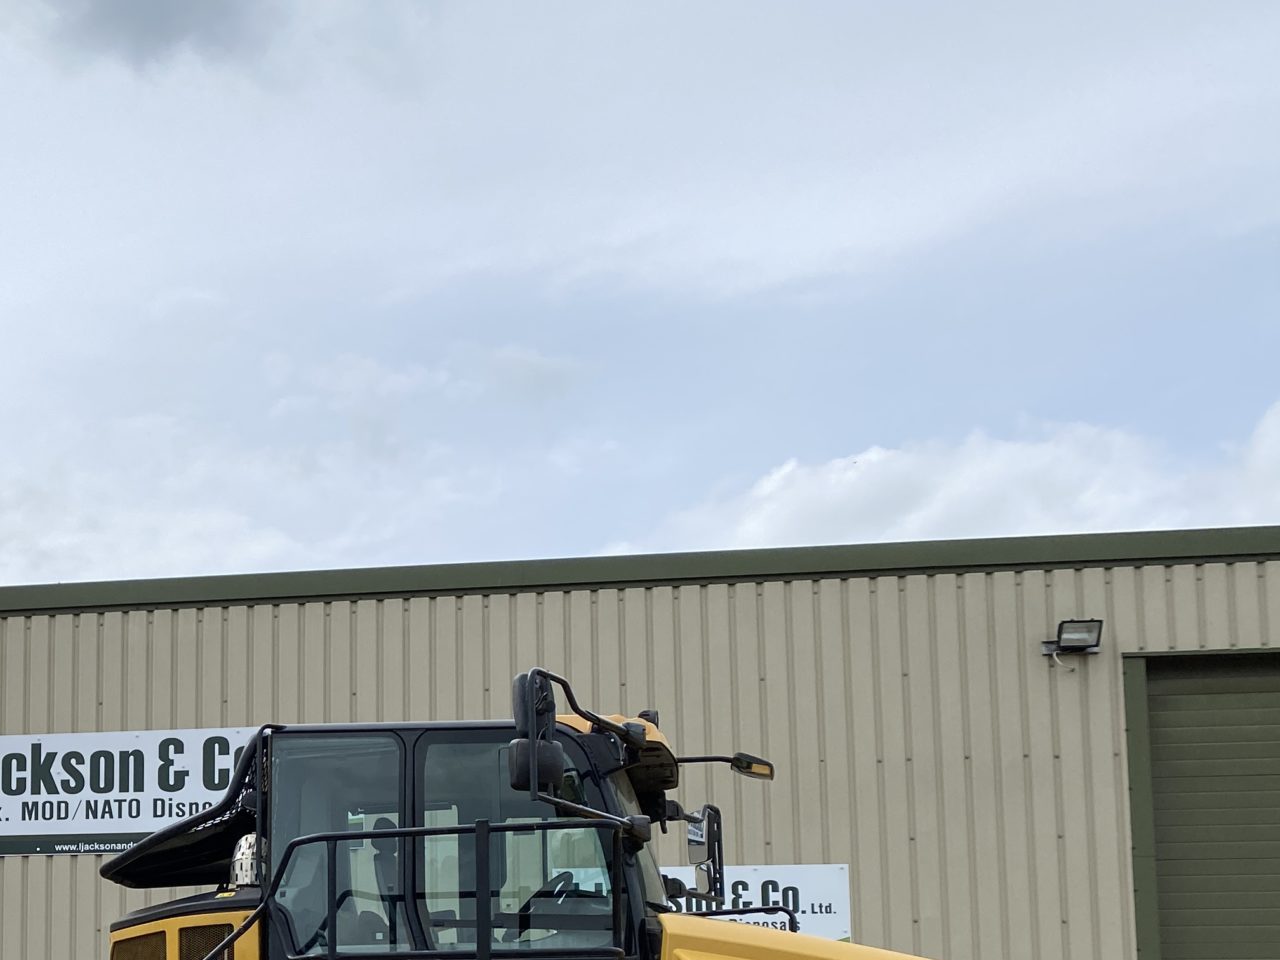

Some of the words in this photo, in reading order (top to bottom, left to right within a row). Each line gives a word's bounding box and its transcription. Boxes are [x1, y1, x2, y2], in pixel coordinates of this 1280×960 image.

[157, 737, 189, 792] &
[21, 798, 141, 822] MOD/NATO
[731, 880, 753, 911] &
[761, 879, 806, 915] Co.
[810, 903, 837, 915] Ltd.
